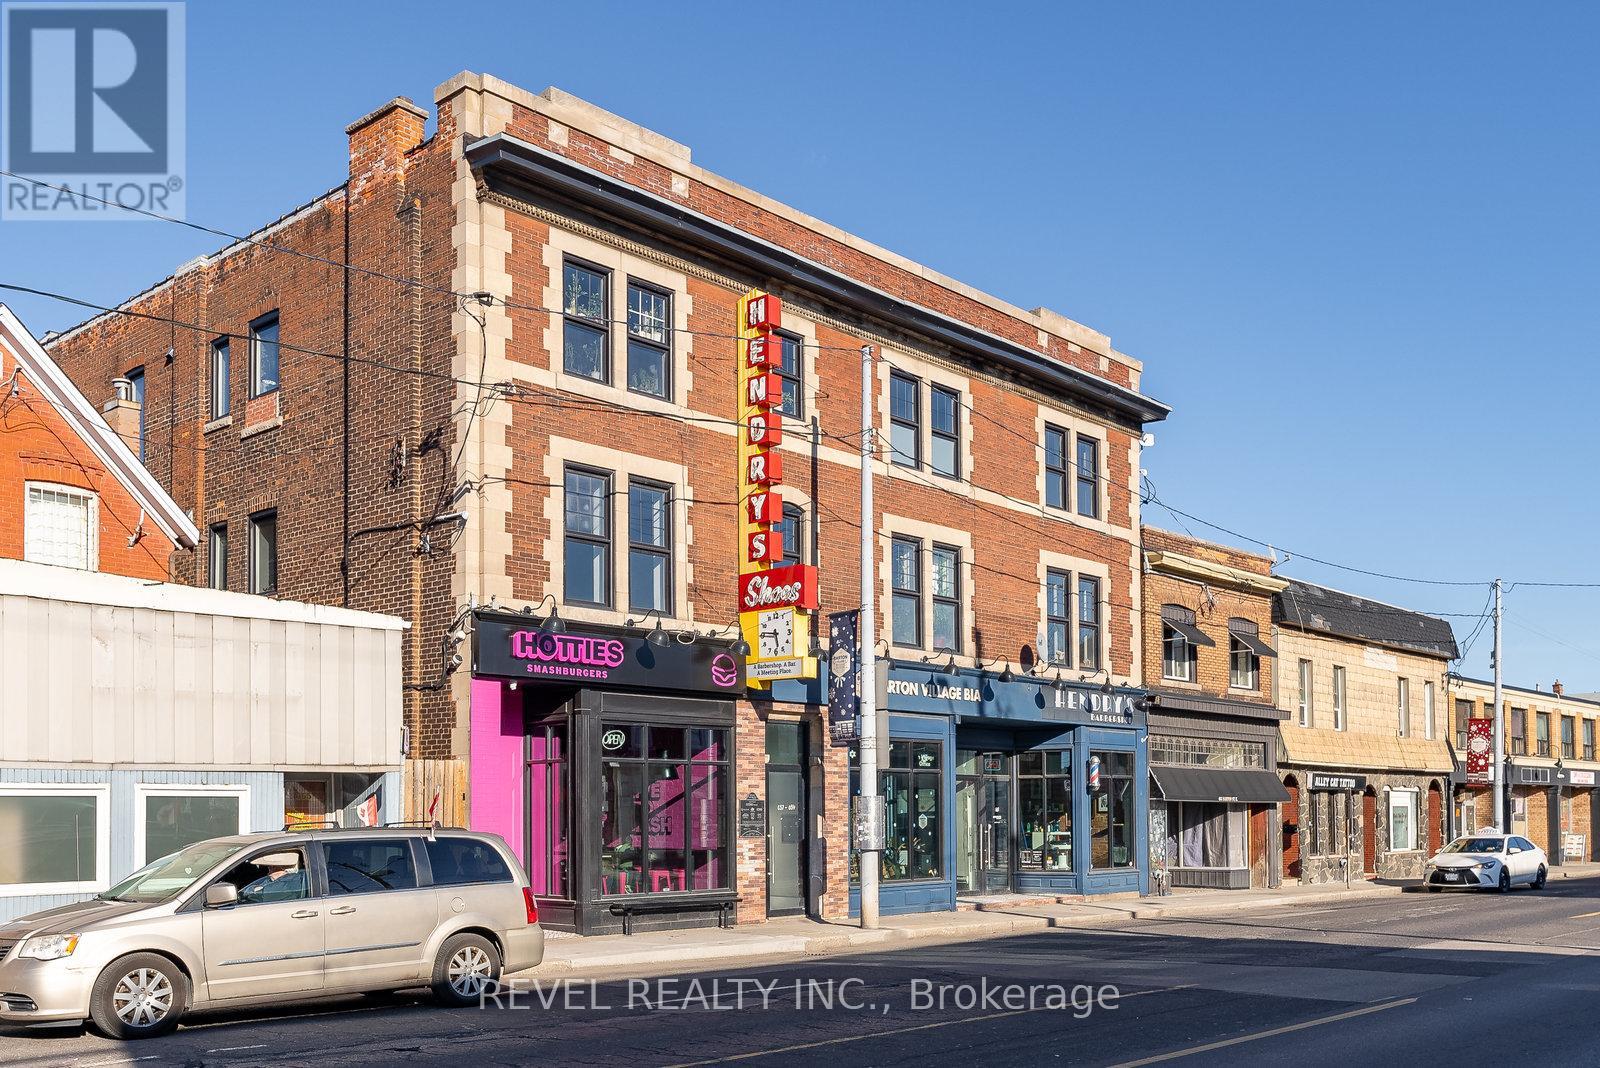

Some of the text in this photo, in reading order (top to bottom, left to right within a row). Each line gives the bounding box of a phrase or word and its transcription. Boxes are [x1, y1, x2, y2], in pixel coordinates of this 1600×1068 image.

[744, 575, 802, 607] Shoes
[513, 630, 624, 668] HOTTIES
[526, 664, 608, 679] SMASHBURGERS
[920, 683, 962, 701] VILLAGE
[963, 687, 982, 702] BIA
[602, 732, 625, 745] OPEN
[1314, 776, 1356, 788] ALLEY CAT TATTOO
